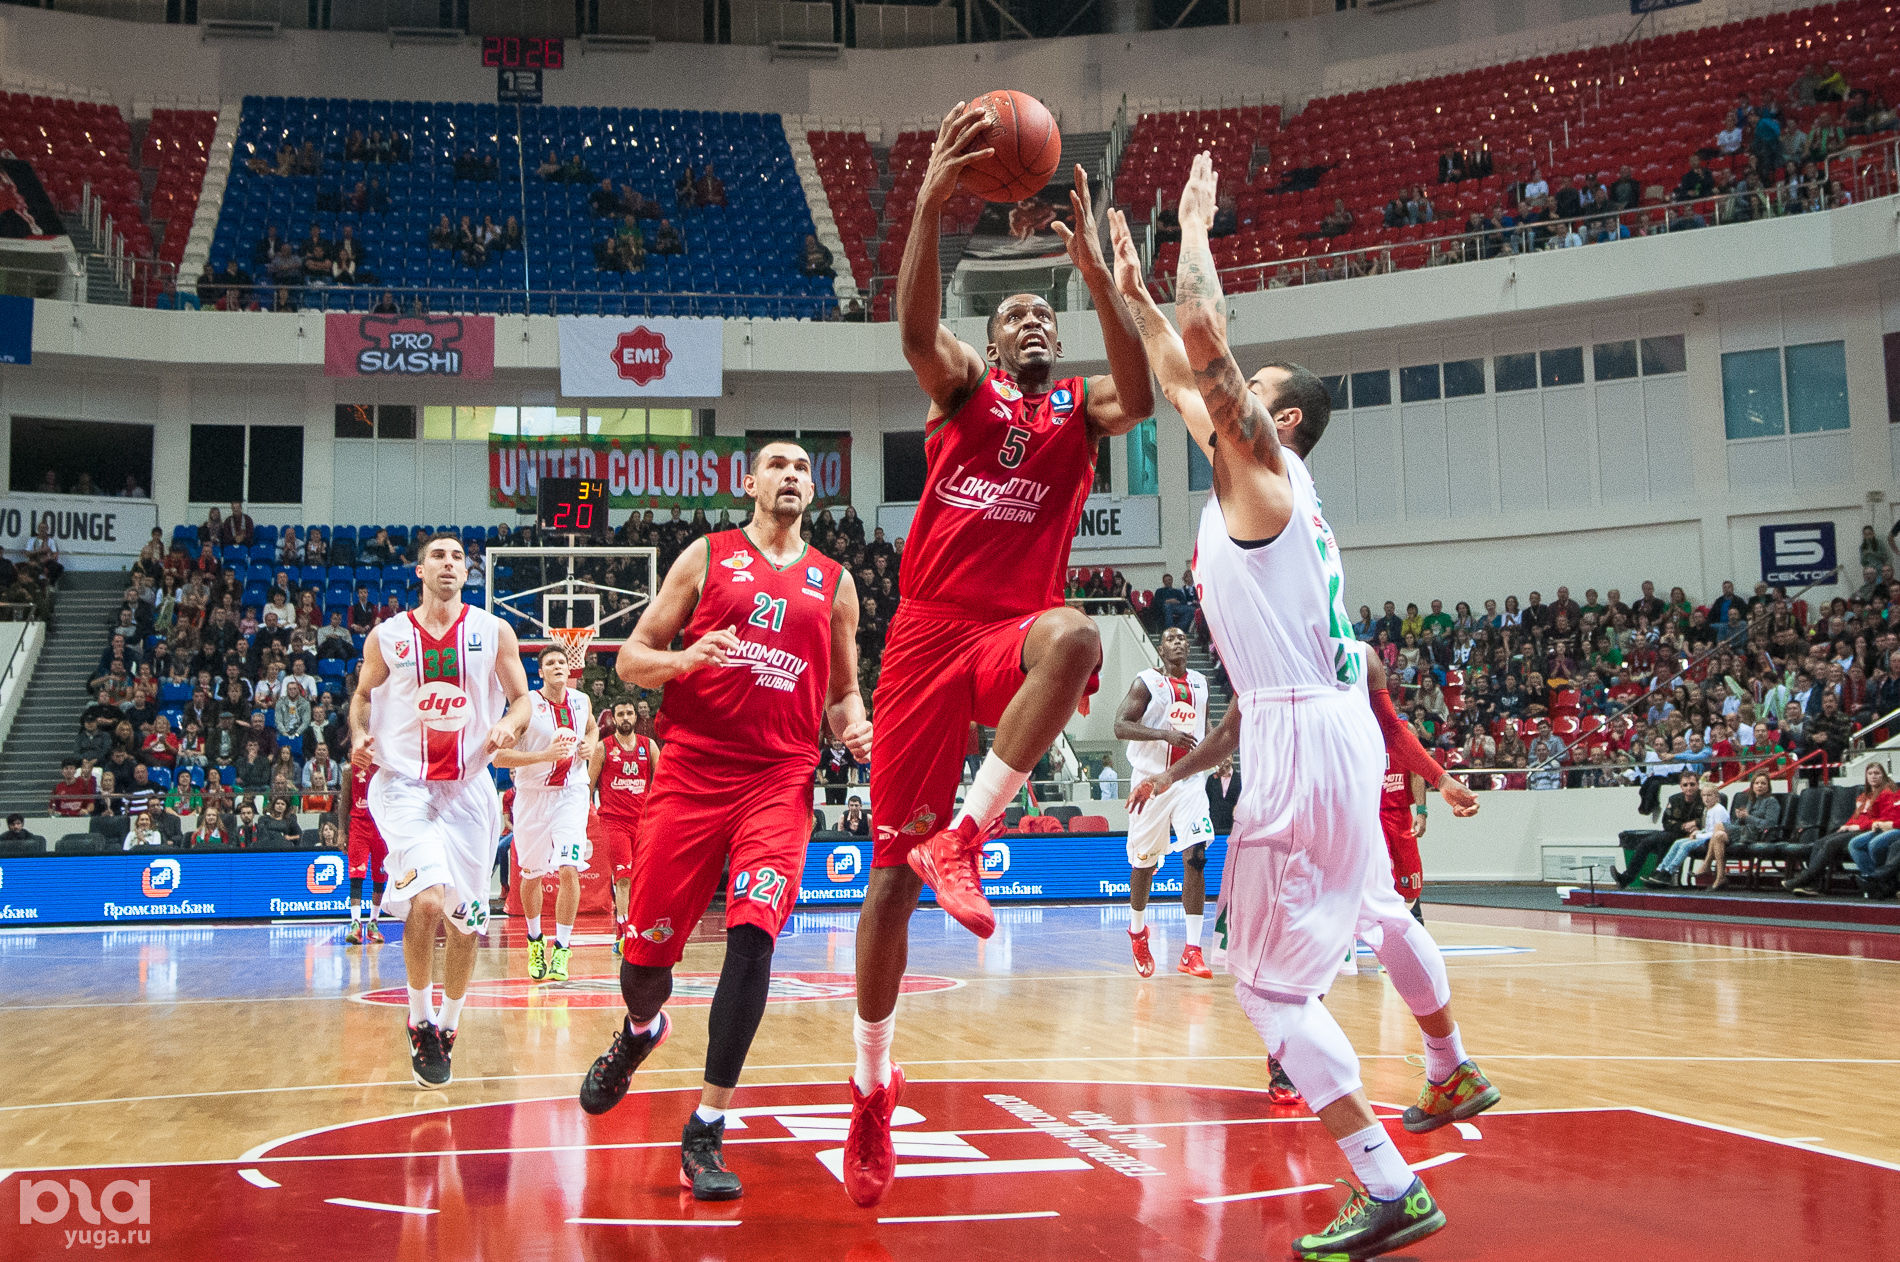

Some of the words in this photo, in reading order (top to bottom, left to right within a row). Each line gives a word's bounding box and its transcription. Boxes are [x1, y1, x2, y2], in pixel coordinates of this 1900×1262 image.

[390, 333, 433, 350] PRO
[360, 351, 459, 374] SUSHI
[998, 425, 1032, 470] 5
[499, 447, 597, 497] UNITED
[608, 449, 719, 497] COLORS
[730, 450, 758, 498] O
[810, 451, 842, 498] KO
[578, 481, 603, 500] 34
[30, 509, 117, 542] LOUNGE
[553, 502, 594, 529] 20
[982, 506, 1037, 524] KUBAN
[1075, 508, 1122, 538] NGE
[1774, 529, 1825, 567] 5
[747, 591, 788, 633] 21
[424, 647, 458, 679] 32
[726, 640, 809, 676] KOMOTIV
[755, 674, 796, 693] KUBAN
[418, 692, 467, 716] dyo
[1170, 708, 1196, 723] dyo
[622, 761, 639, 776] 44
[1202, 816, 1213, 834] 3
[571, 844, 580, 861] 5
[748, 866, 788, 912] 21
[103, 899, 216, 921] Промсвязьбанк
